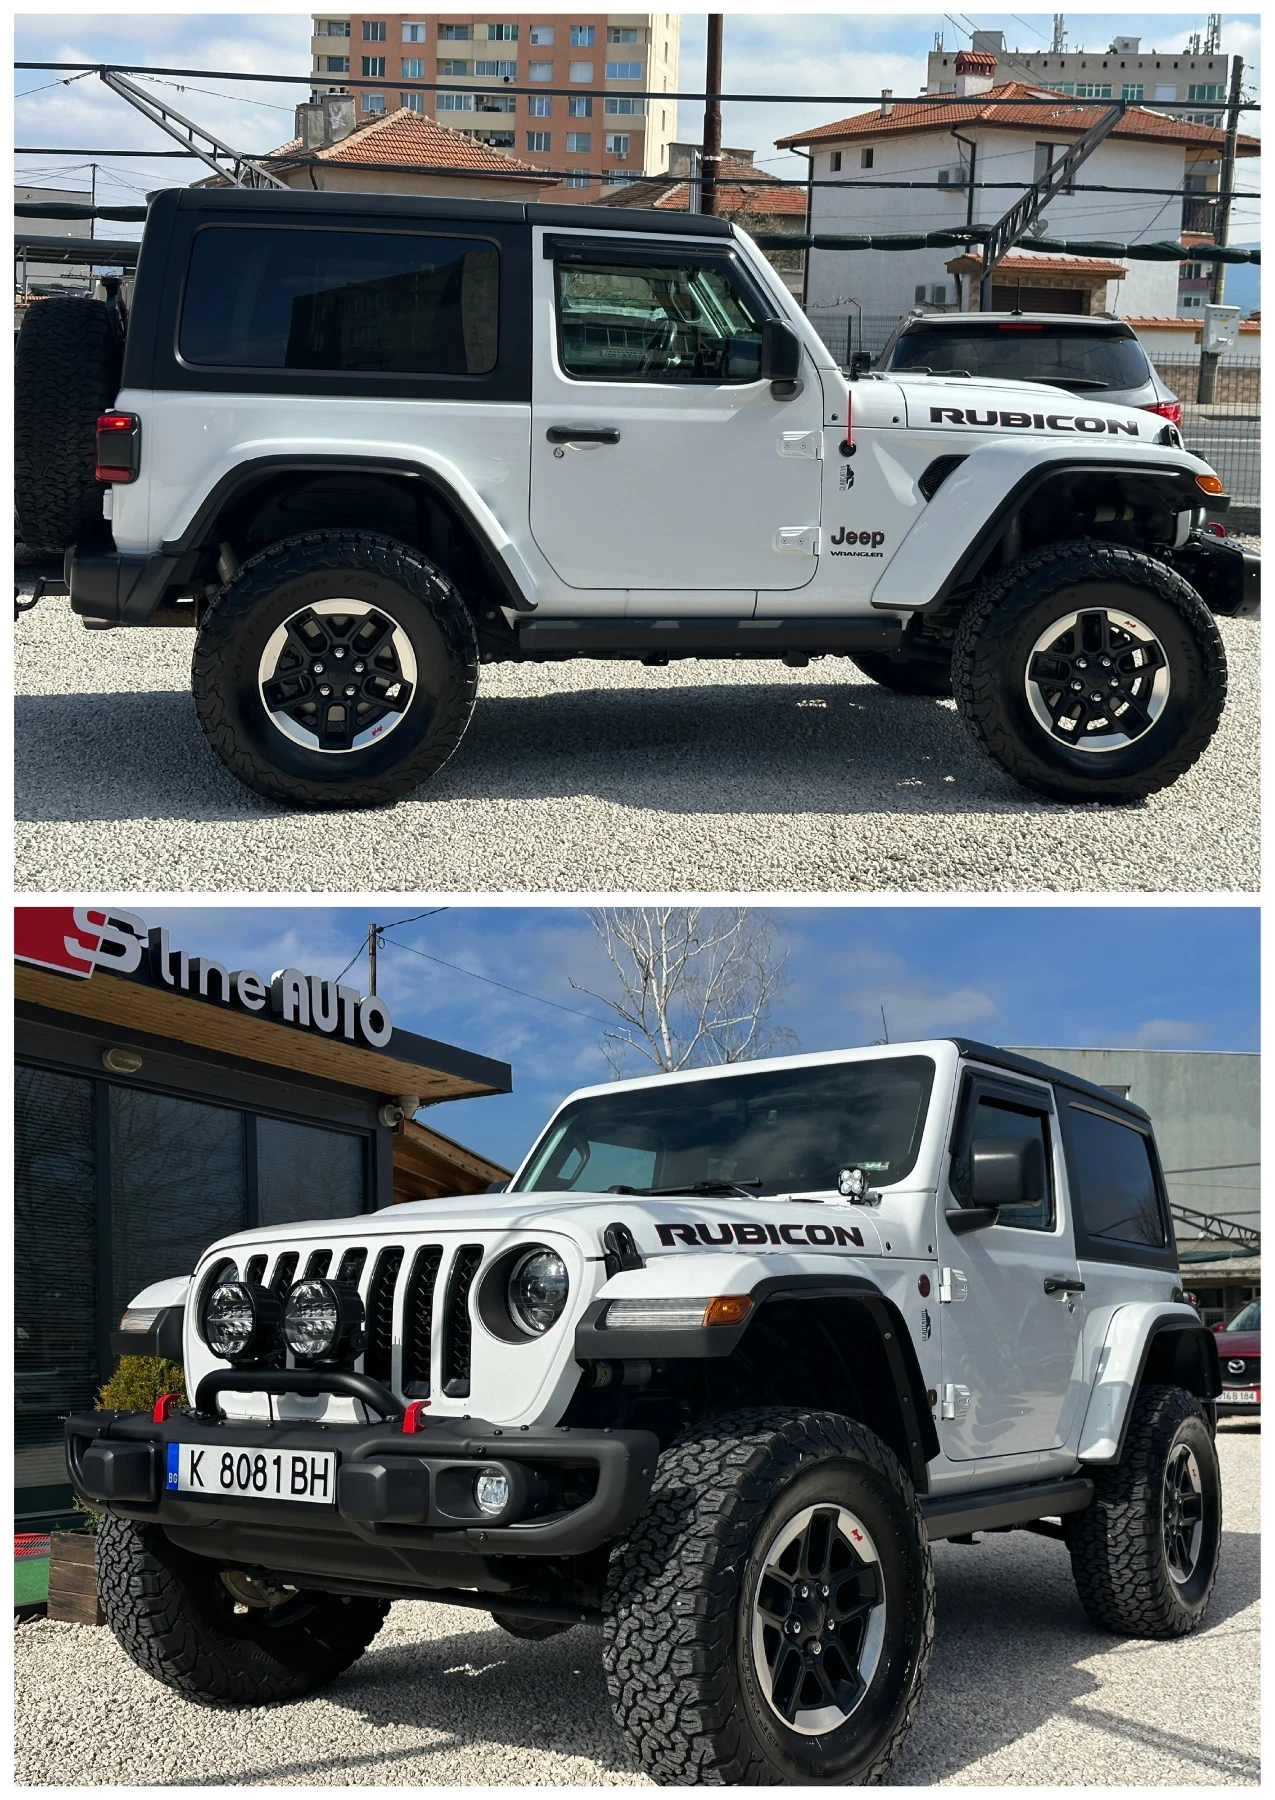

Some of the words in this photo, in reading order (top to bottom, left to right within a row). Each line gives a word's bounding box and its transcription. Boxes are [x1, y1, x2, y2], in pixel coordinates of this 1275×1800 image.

[929, 406, 1139, 436] RUBICON
[830, 526, 885, 548] Jeep
[830, 550, 884, 558] WRANGLER
[278, 967, 393, 1048] AUTO
[653, 1223, 865, 1247] RUBICON
[168, 1472, 178, 1484] BG
[190, 1449, 205, 1487] K
